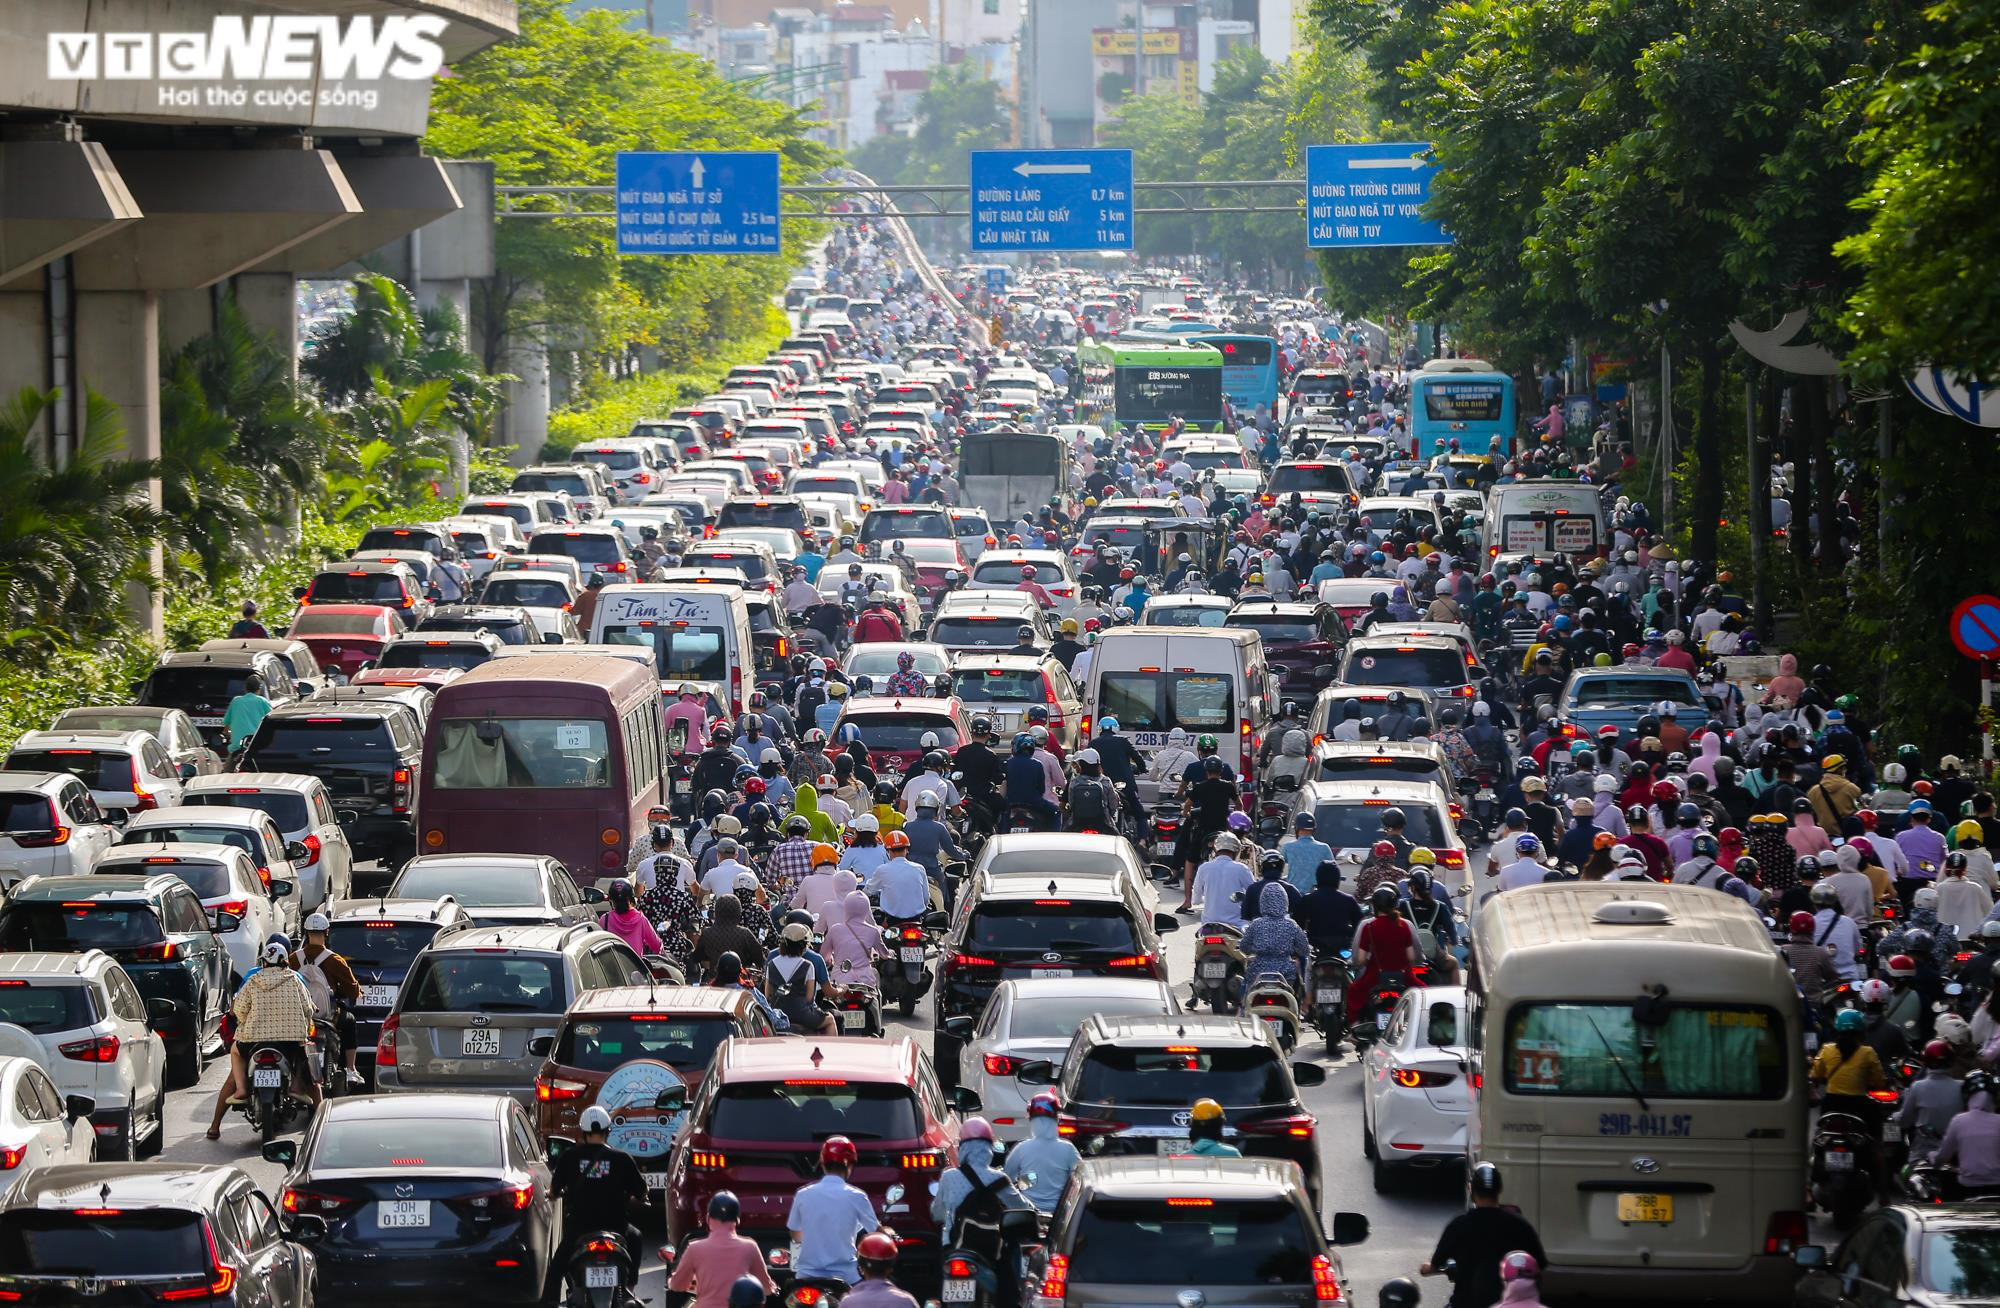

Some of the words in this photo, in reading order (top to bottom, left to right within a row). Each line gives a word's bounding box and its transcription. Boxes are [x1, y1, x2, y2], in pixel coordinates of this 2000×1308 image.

[978, 186, 1012, 202] ĐƯỜNG
[1015, 186, 1041, 202] LÁNG
[1109, 189, 1125, 201] km
[1312, 181, 1346, 198] ĐƯỜNG
[1350, 180, 1388, 197] TRƯỜNG
[1391, 183, 1421, 196] CHINH
[642, 191, 665, 204] GIAO
[978, 207, 998, 223] NÚT
[1000, 210, 1023, 223] GIAO
[1026, 206, 1046, 222] CẦU
[1048, 205, 1070, 223] GIẤY
[1100, 209, 1107, 222] 5
[1109, 210, 1125, 222] km
[1313, 203, 1332, 218] NÚT
[1334, 205, 1357, 218] GIAO
[1359, 203, 1380, 217] NGÃ
[1382, 204, 1395, 217] TƯ
[642, 212, 665, 225] GIAO
[759, 212, 776, 225] km
[978, 227, 998, 244] CẦU
[1001, 229, 1027, 245] NHẬT
[1031, 229, 1050, 243] TÂN
[1097, 230, 1107, 242] 11
[1109, 230, 1125, 242] km
[1313, 222, 1332, 239] CẦU
[1336, 224, 1359, 238] VĨNH
[1363, 225, 1381, 238] TUY
[760, 232, 776, 245] km
[618, 598, 660, 618] Tâm
[568, 737, 580, 746] 02
[368, 986, 387, 996] 30H
[471, 1029, 491, 1042] 29A
[464, 1041, 498, 1055] 012.75
[1521, 1057, 1555, 1079] 14
[1599, 1112, 1693, 1137] 29B-041.97
[393, 1201, 416, 1213] 30H
[1635, 1195, 1658, 1208] 29B
[383, 1214, 425, 1226] 013.35
